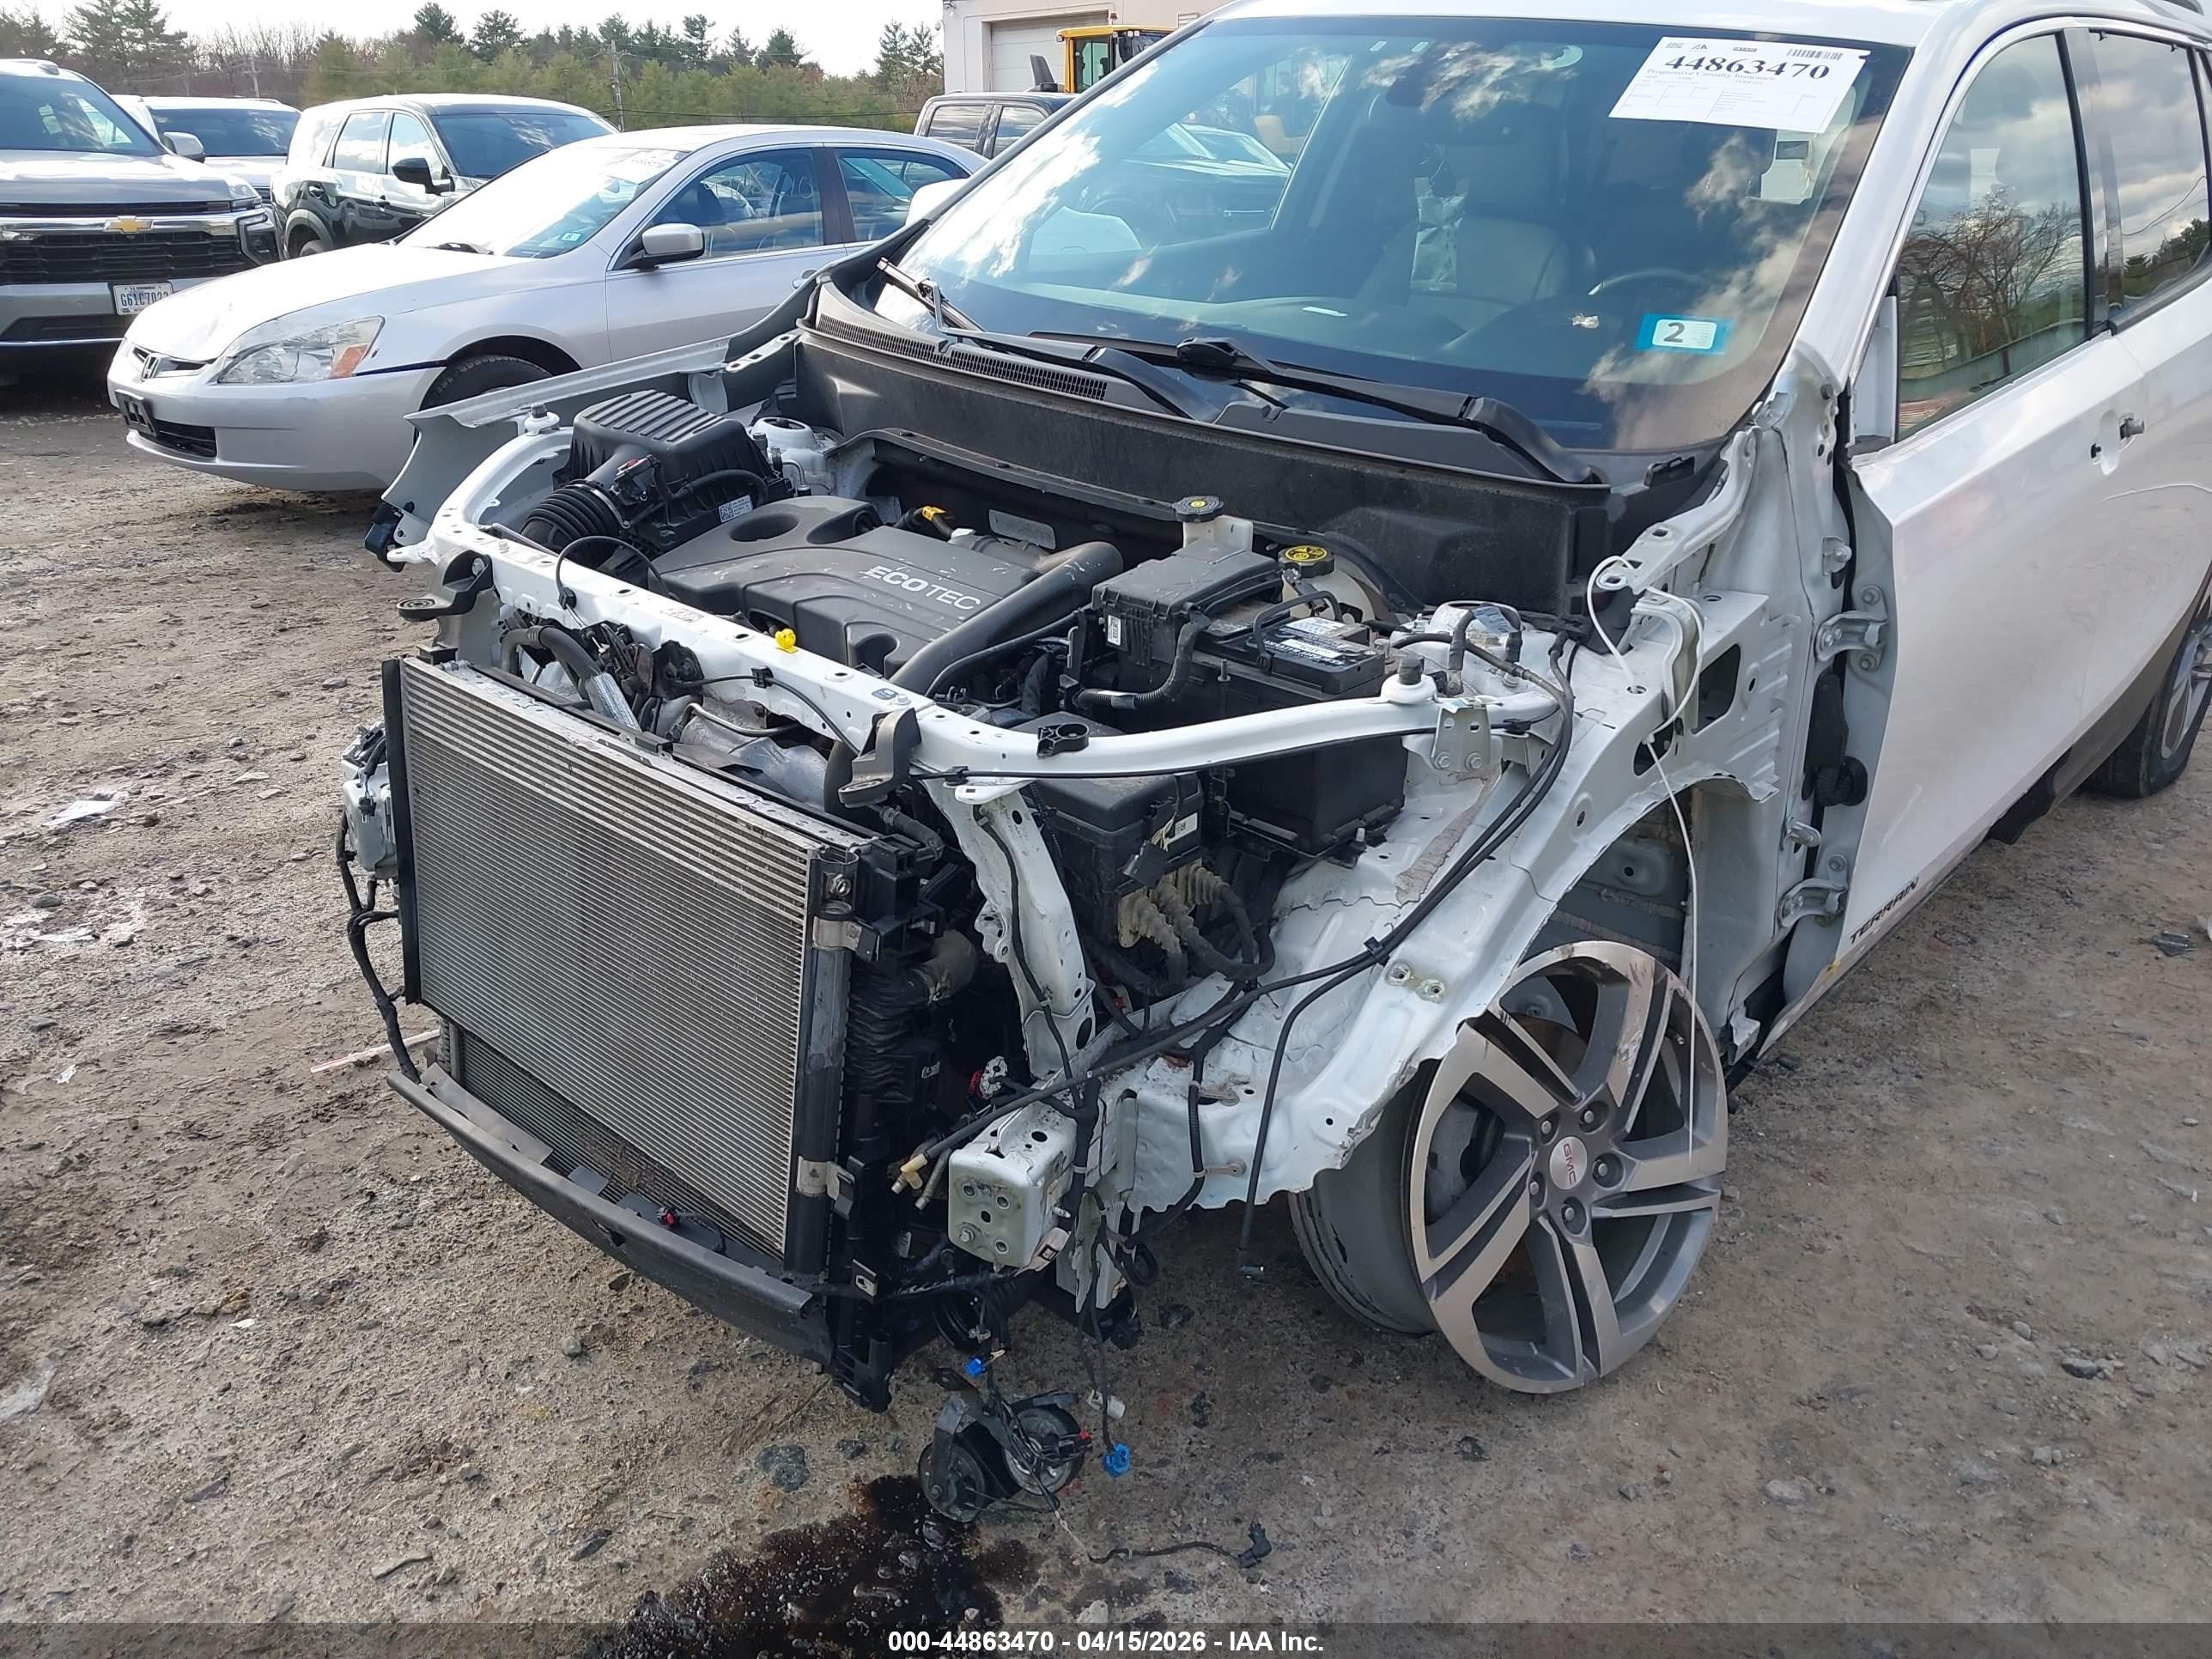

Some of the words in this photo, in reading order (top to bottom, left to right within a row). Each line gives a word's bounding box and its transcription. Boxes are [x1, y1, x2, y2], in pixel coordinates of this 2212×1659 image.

[1664, 55, 1831, 80] 44863470
[1663, 321, 1686, 343] 2
[864, 565, 981, 610] ECOTEC
[1850, 876, 1920, 945] TERRAIN
[1563, 1143, 1577, 1184] GMC
